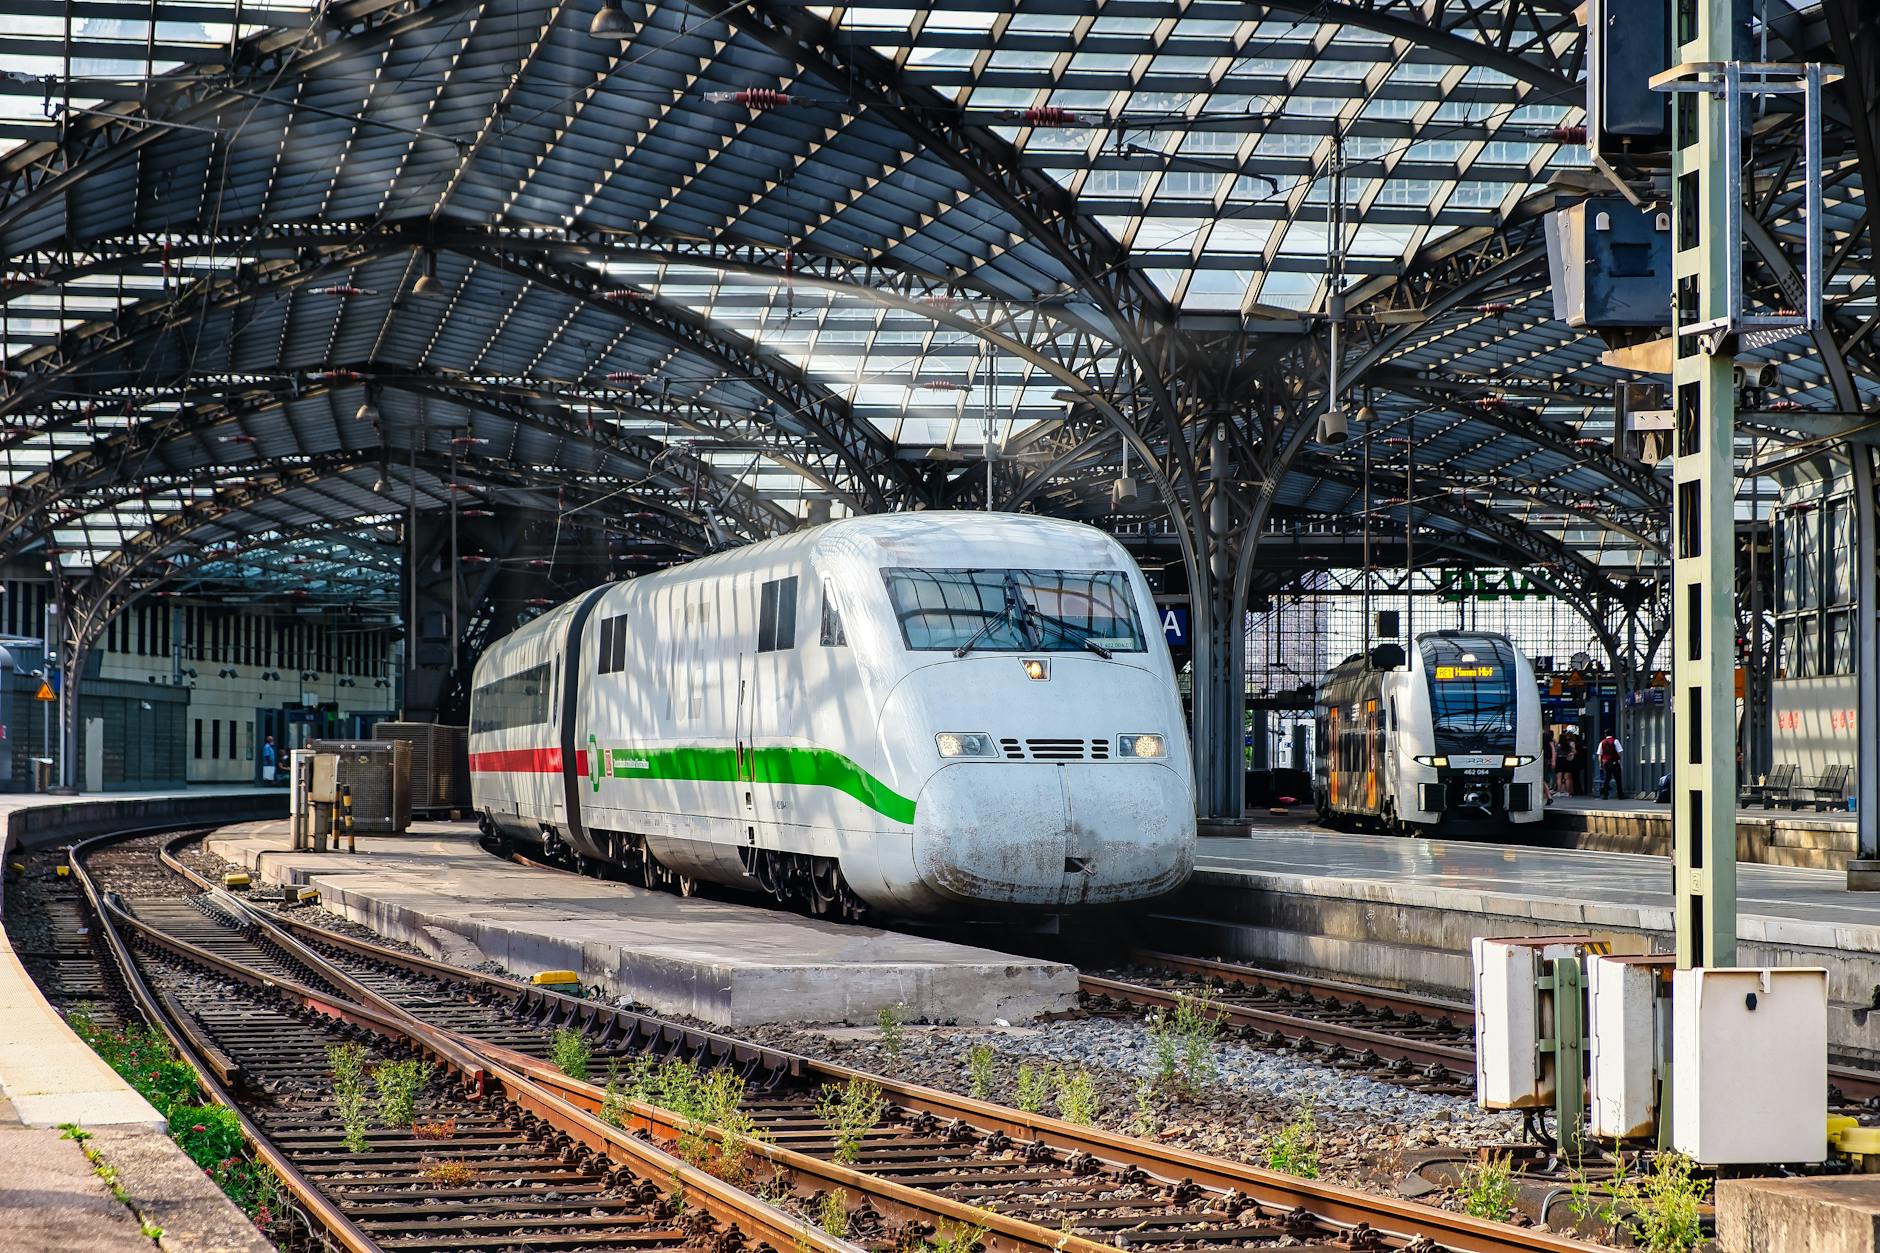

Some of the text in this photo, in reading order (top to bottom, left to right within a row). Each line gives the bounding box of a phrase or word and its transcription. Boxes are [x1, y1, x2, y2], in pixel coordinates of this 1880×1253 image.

[1164, 611, 1181, 637] A
[1537, 656, 1546, 669] 4
[1455, 666, 1476, 676] Hamm
[1478, 666, 1492, 676] Hbf
